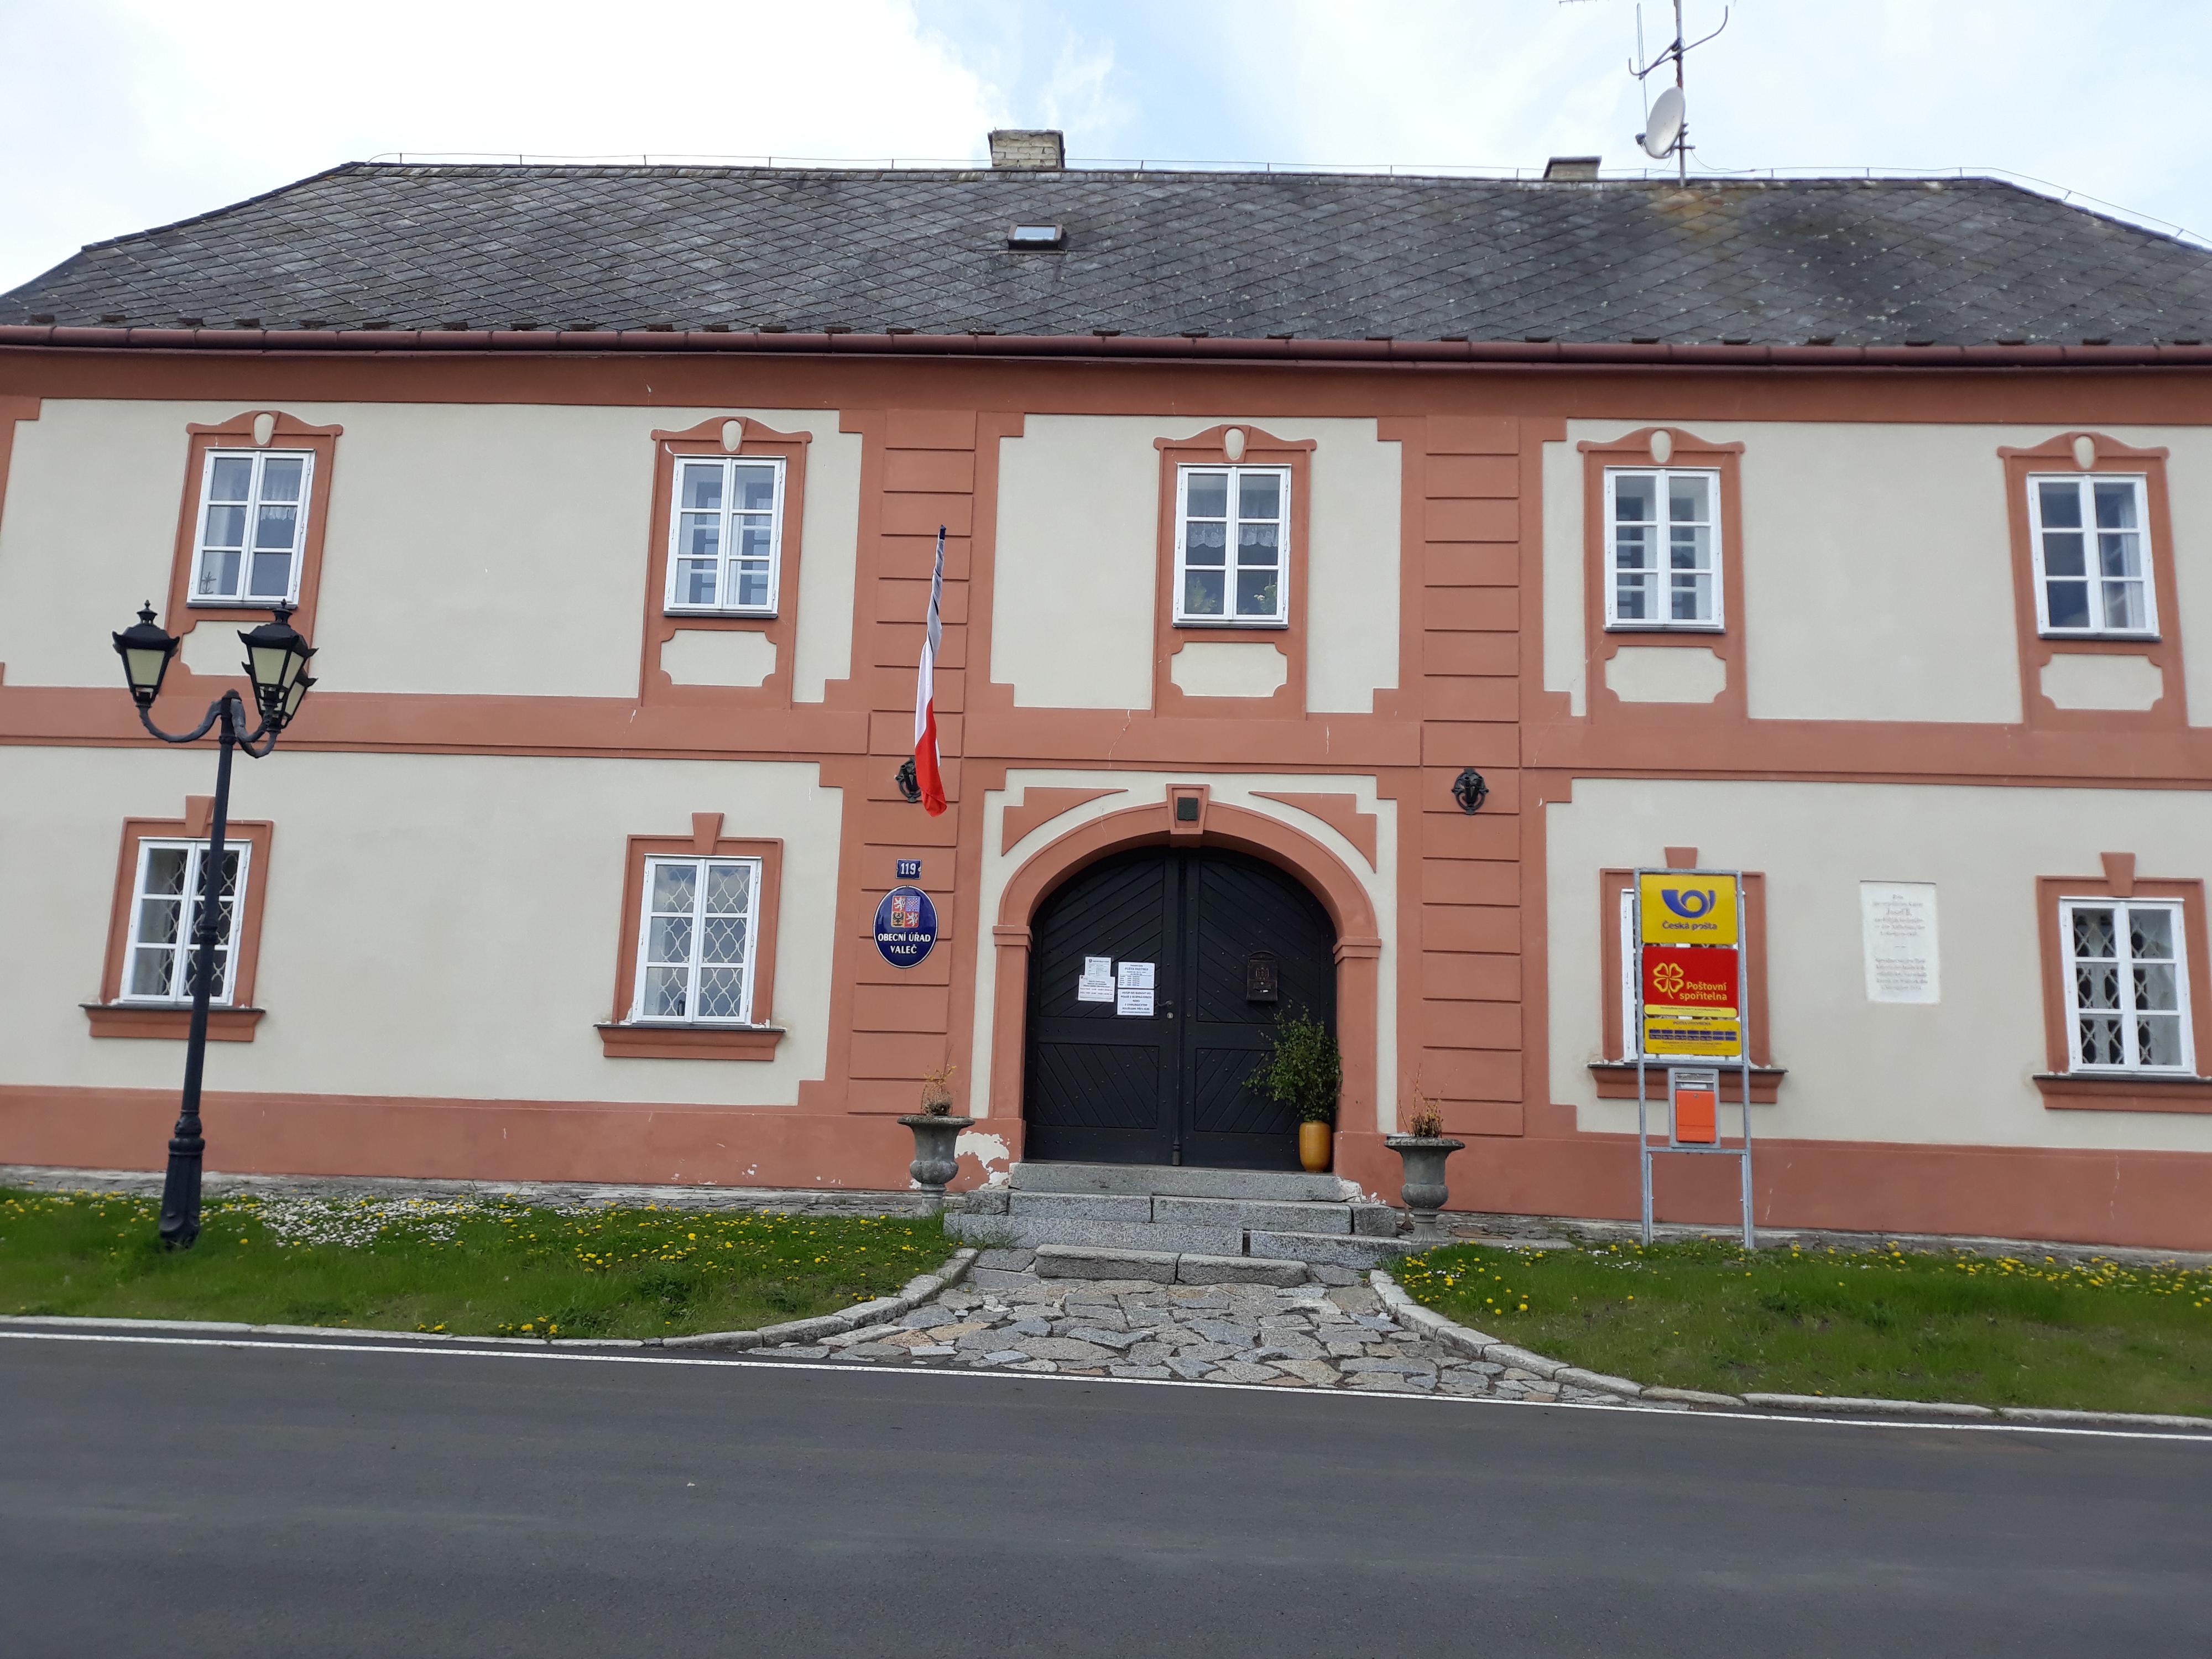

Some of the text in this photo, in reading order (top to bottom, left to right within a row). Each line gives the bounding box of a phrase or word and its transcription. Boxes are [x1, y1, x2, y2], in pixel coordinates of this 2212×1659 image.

[901, 862, 916, 875] 119
[1662, 920, 1718, 931] Česká pošta
[878, 931, 931, 942] OBECNÍ ÚŘAD
[890, 944, 917, 954] VALEČ
[1687, 981, 1727, 991] Poštovní
[1679, 992, 1728, 1001] spořitelna
